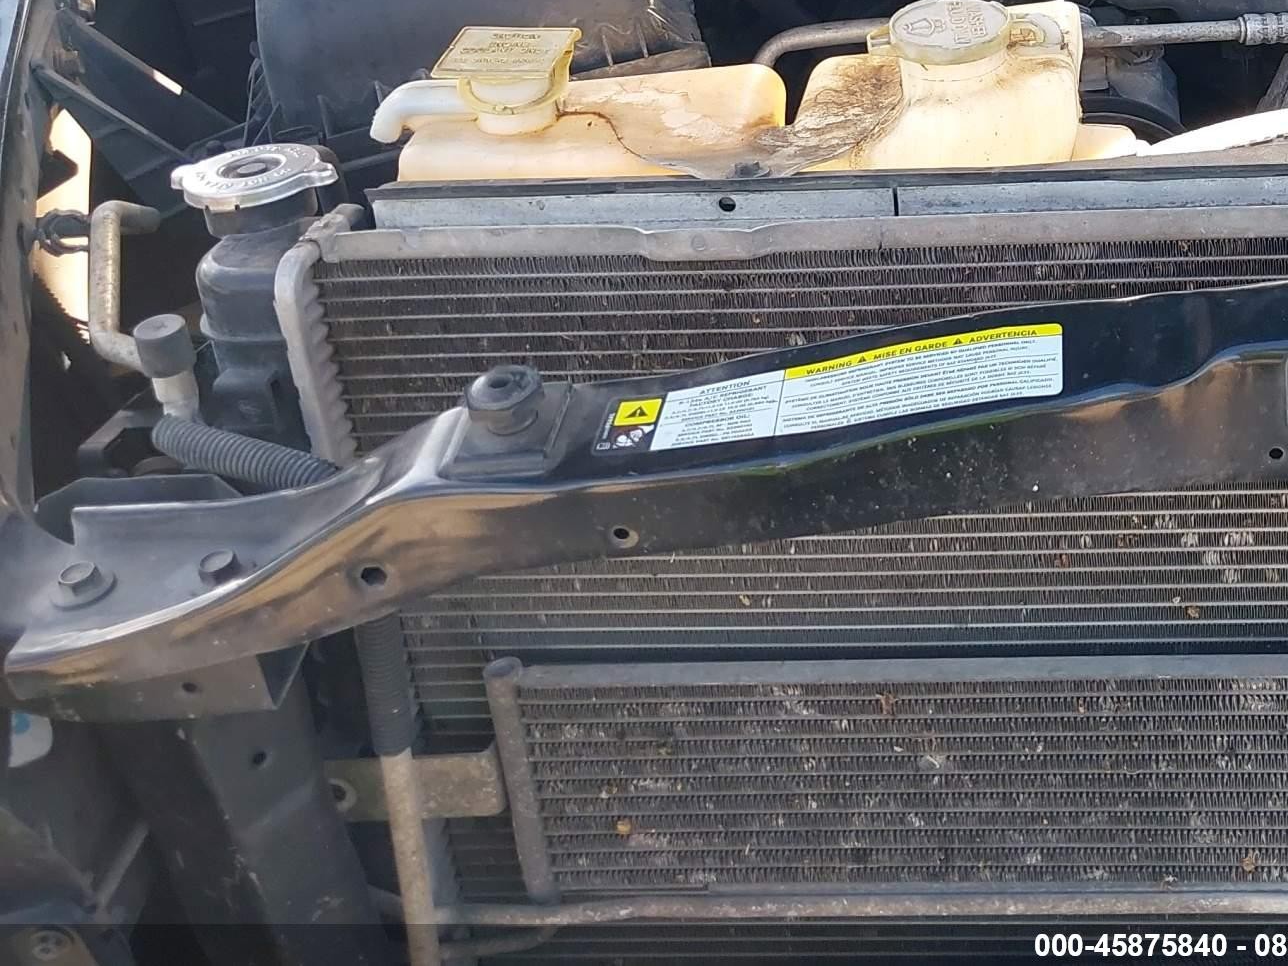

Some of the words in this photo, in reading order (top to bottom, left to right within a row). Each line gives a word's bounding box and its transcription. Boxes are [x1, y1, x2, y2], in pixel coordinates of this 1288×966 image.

[806, 360, 852, 375] WARNING
[873, 349, 897, 360] MISE
[899, 346, 912, 355] EN
[914, 341, 947, 352] GARDE
[969, 330, 1038, 343] ADVERTENCIA
[699, 380, 751, 395] ATTENTION
